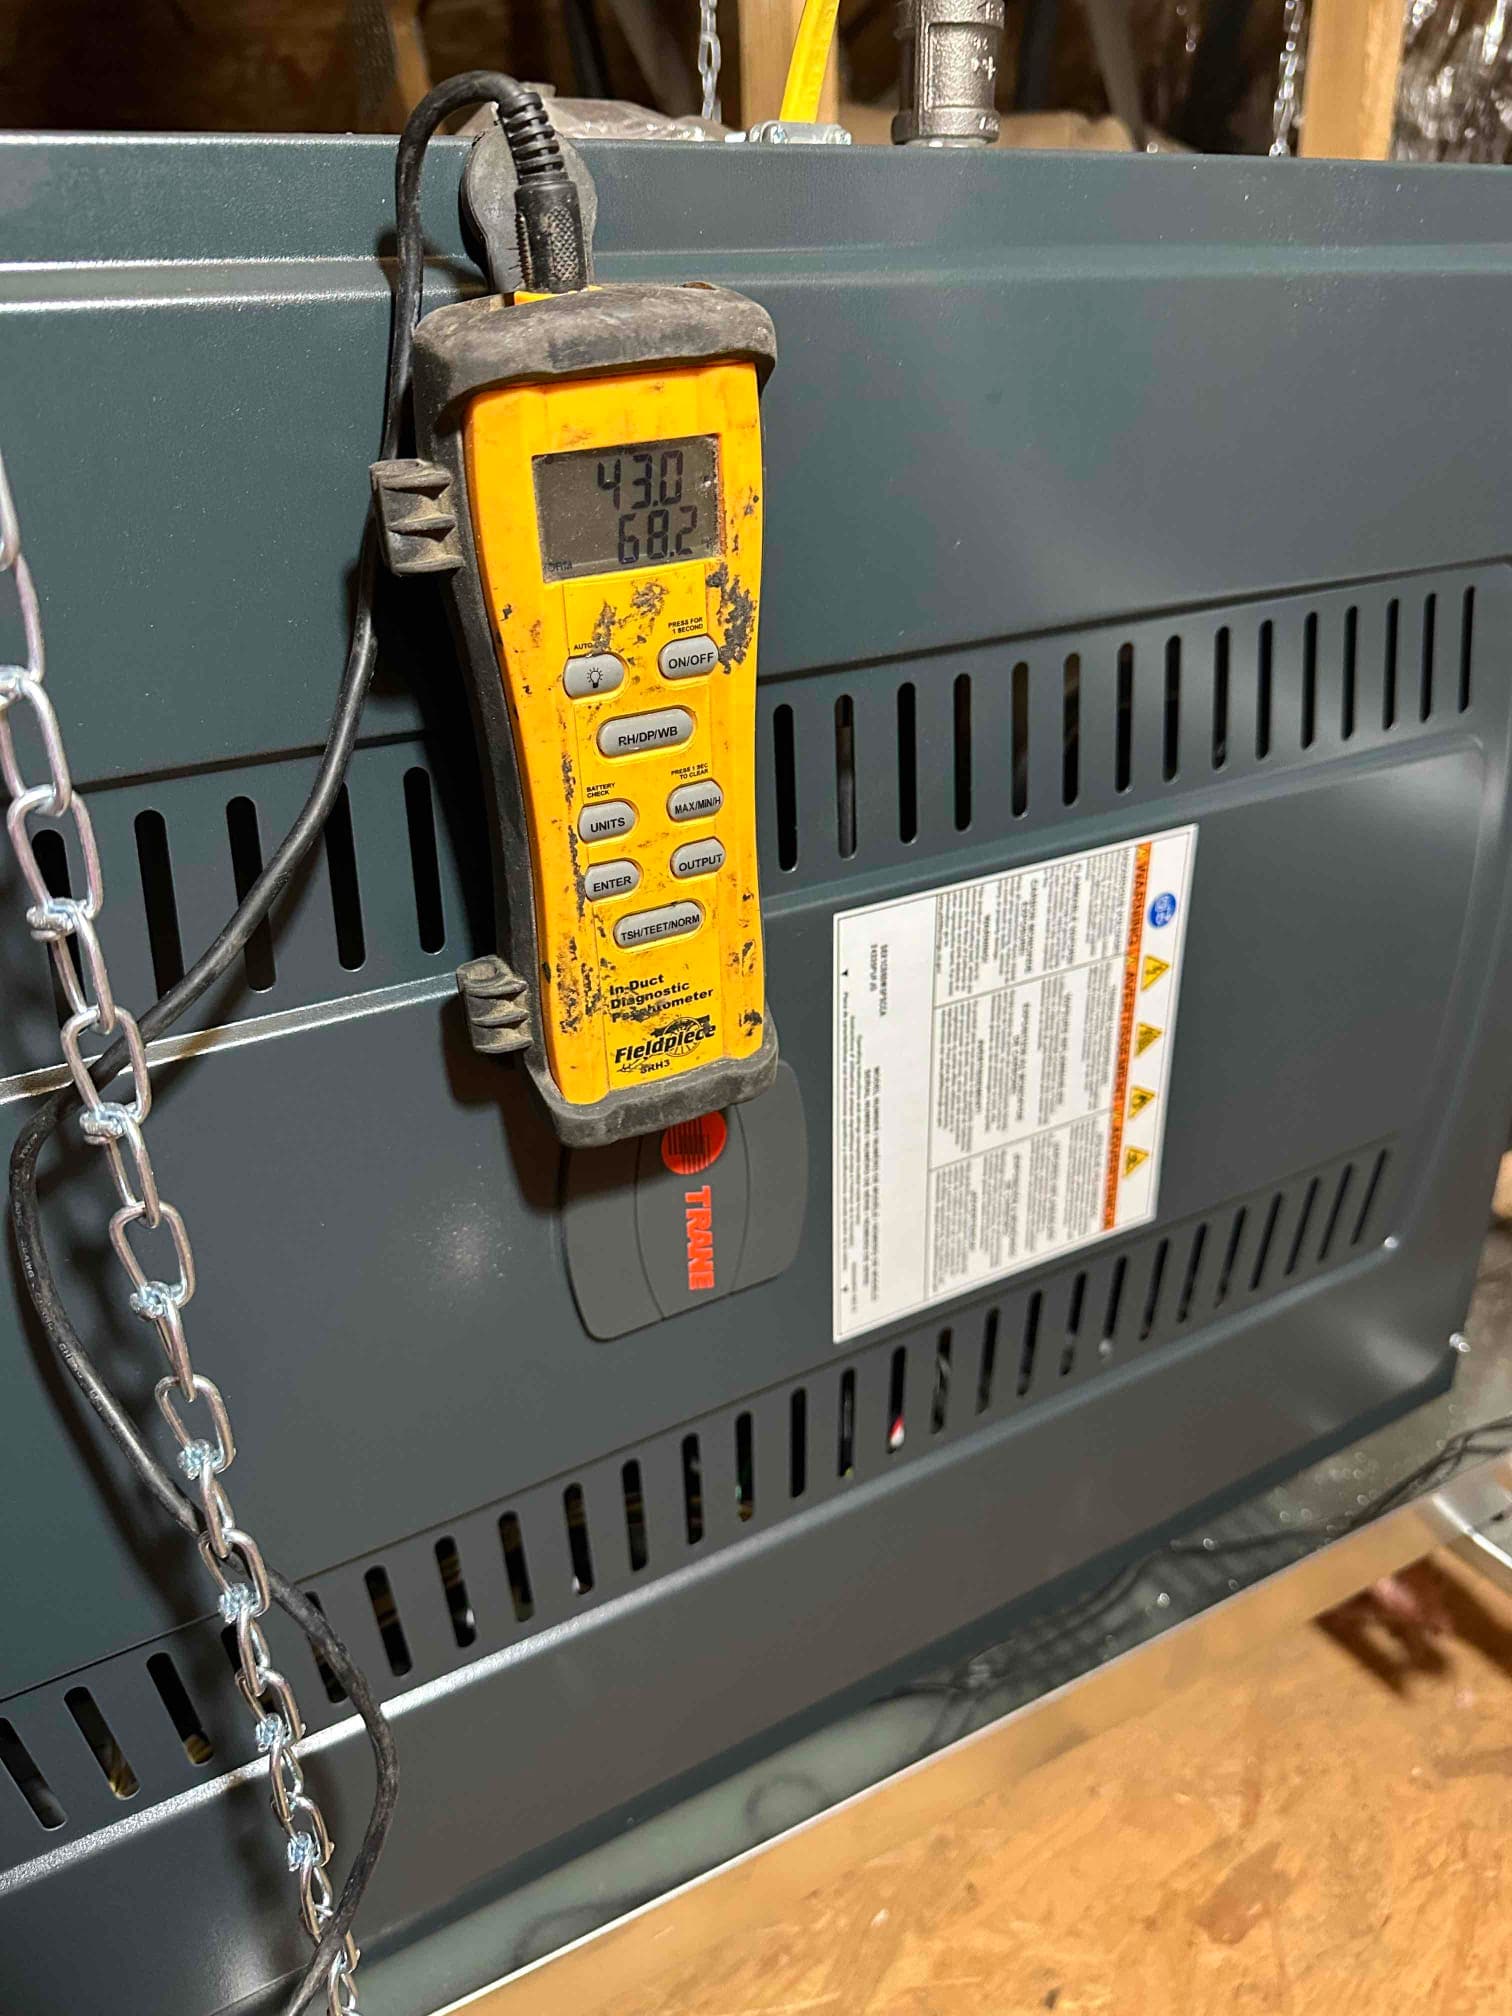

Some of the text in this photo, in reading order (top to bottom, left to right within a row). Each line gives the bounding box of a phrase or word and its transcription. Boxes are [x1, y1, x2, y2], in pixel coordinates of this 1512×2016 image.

[597, 449, 684, 510] 43.0
[617, 505, 698, 565] 68.2
[668, 616, 703, 628] PRESS FOR
[677, 623, 704, 633] SECOND
[574, 642, 593, 650] AUTO
[668, 651, 715, 670] ON/OFF
[617, 725, 679, 747] RH/DP/WB
[671, 767, 691, 776] PRESS
[689, 768, 709, 778] CLEAR
[586, 782, 616, 793] BATTERY
[586, 790, 610, 799] CHECK
[674, 796, 721, 815] MAX/MIN/H
[589, 817, 626, 833] UNITS
[678, 853, 723, 872] OUTPUT
[593, 875, 632, 892] ENTER
[1128, 862, 1149, 947] WARNING
[620, 914, 701, 941] TSH/TEET/NORM
[609, 974, 665, 996] In-Duct
[610, 982, 690, 1010] Diagnostic
[611, 989, 714, 1023] Pshrometer
[615, 1024, 717, 1064] Fieldpiece
[639, 1059, 671, 1074] SRH3
[685, 1184, 715, 1291] TRANE
